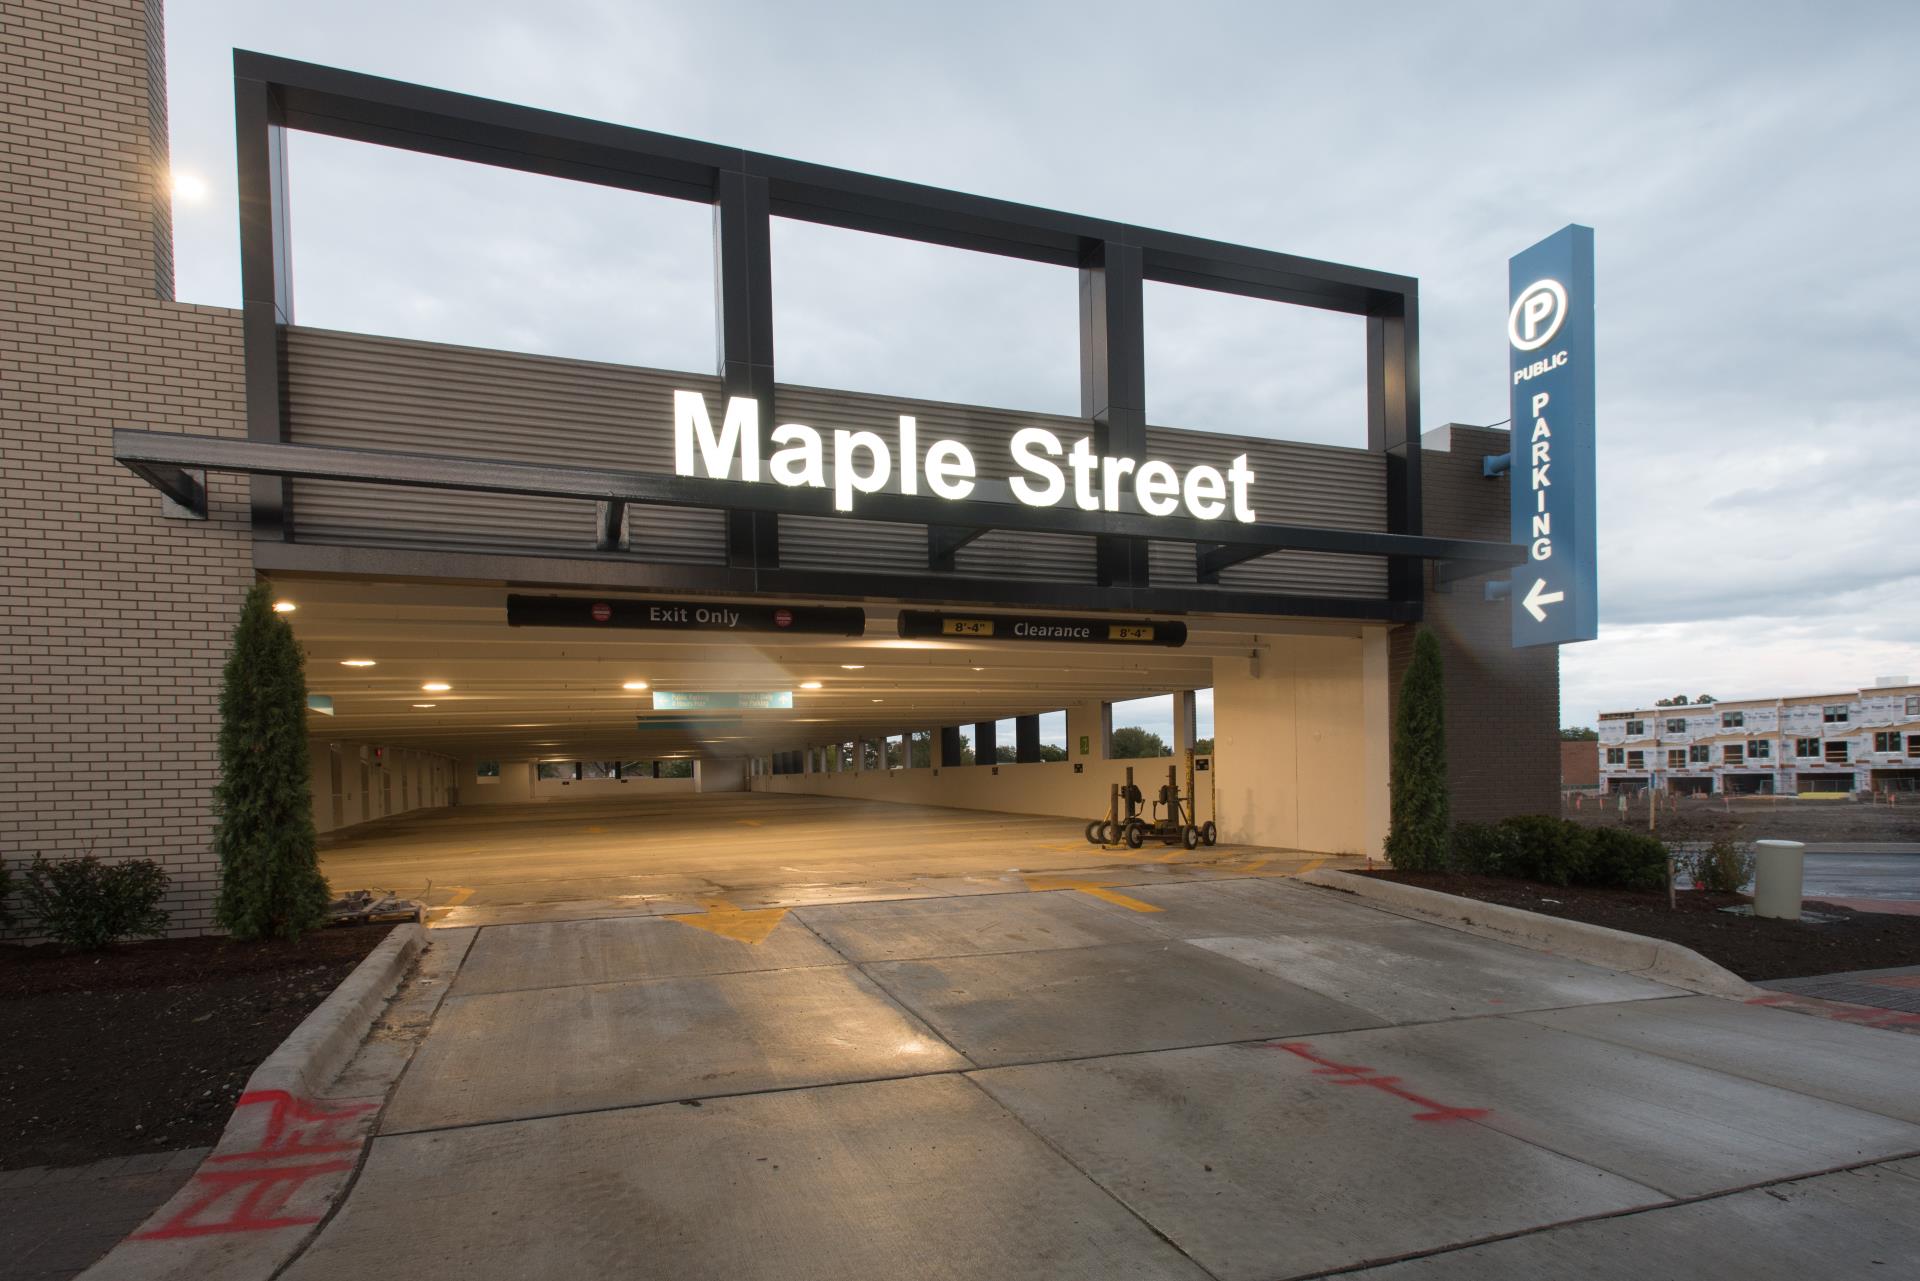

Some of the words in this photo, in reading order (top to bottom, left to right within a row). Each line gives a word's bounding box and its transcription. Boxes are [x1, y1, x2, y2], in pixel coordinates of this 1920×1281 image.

[1524, 292, 1554, 341] P
[1513, 351, 1568, 385] PUBLIC
[674, 390, 976, 511] Maple
[1009, 427, 1256, 523] Street
[1531, 392, 1552, 561] PARKING
[650, 607, 688, 622] Exit
[695, 608, 740, 627] Only
[1014, 622, 1090, 638] Clearance
